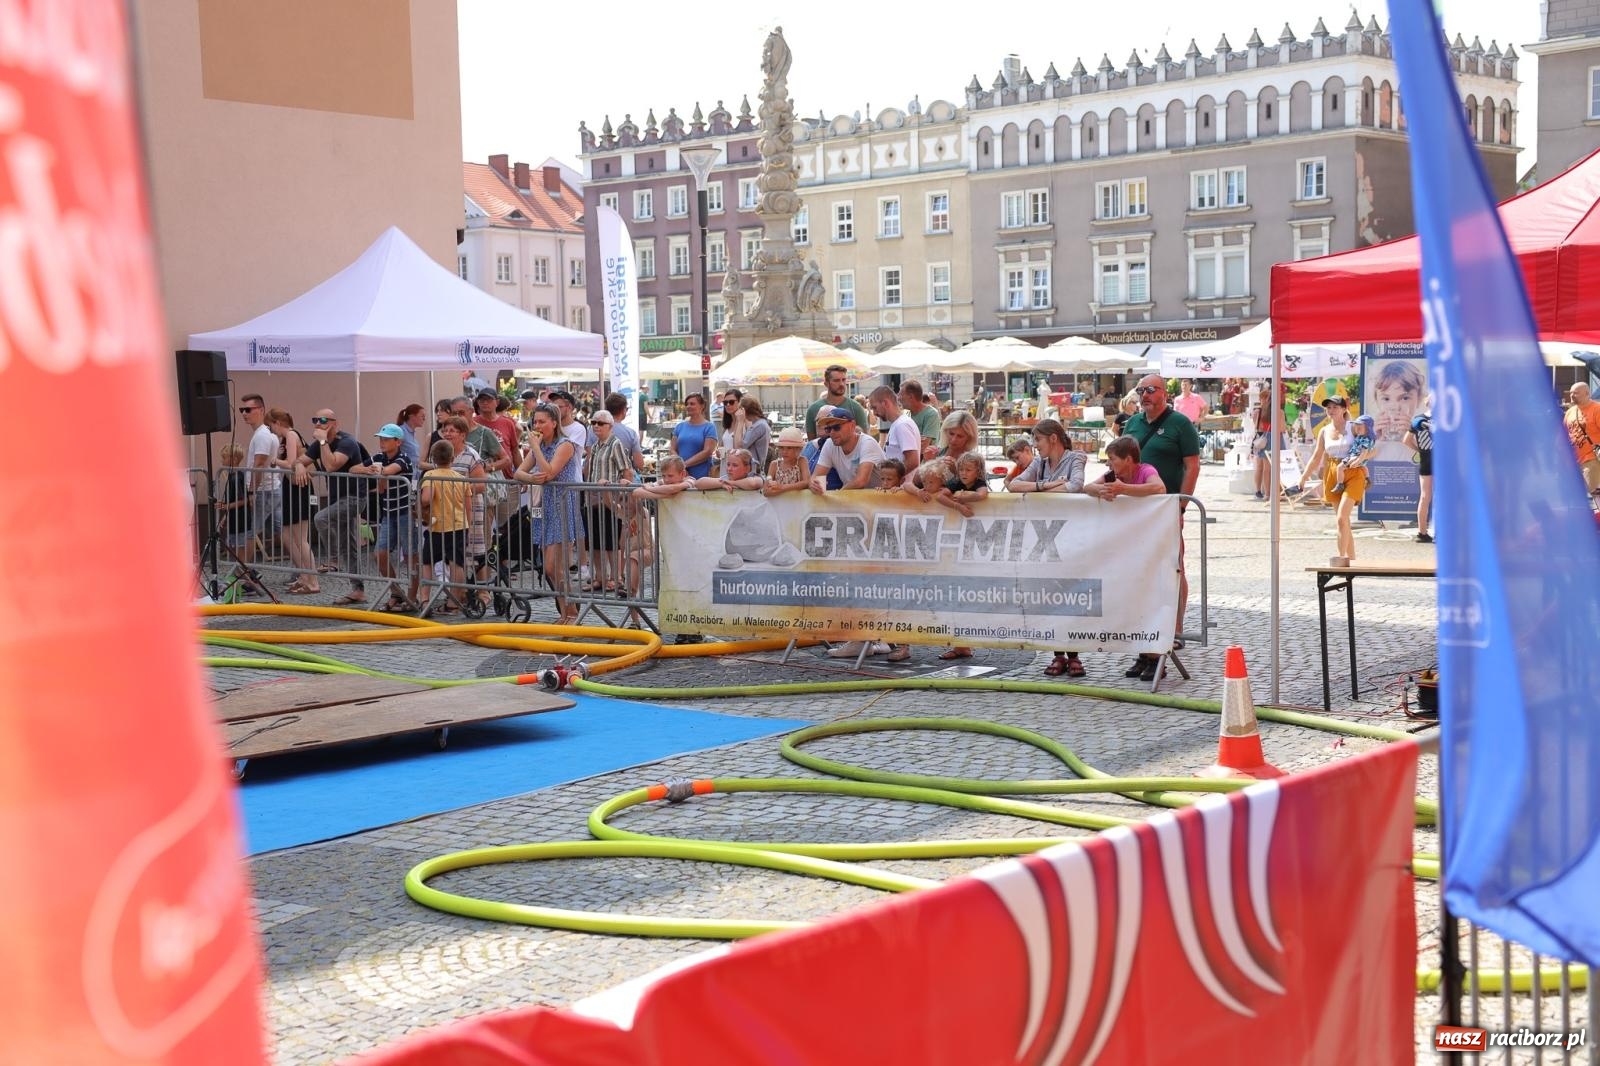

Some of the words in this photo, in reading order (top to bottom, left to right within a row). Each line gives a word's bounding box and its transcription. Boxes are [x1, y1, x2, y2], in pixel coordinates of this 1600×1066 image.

[640, 338, 685, 351] KANTOR
[853, 332, 883, 344] SHIRO
[1101, 331, 1149, 343] Manufaktura
[1151, 330, 1179, 341] Lodów
[803, 514, 1068, 563] GRAN-MIX
[719, 579, 788, 597] hurtownia
[792, 581, 849, 599] kamieni
[854, 583, 943, 605] naturalnych
[949, 586, 953, 601] i
[957, 586, 1006, 604] kostki
[1012, 586, 1092, 610] brukowej
[665, 613, 688, 624] 47-400
[689, 614, 726, 625] Racibórz,
[732, 616, 743, 626] ul.
[744, 617, 790, 629] Walentego
[792, 618, 824, 630] Zająca
[826, 619, 833, 629] 7
[858, 620, 875, 631] 518
[877, 621, 894, 631] 217
[895, 622, 912, 632] 634
[917, 624, 950, 635] e-mail:
[954, 627, 1055, 640] granmix@interia.pl
[1068, 631, 1160, 642] www.gran-mix.pl
